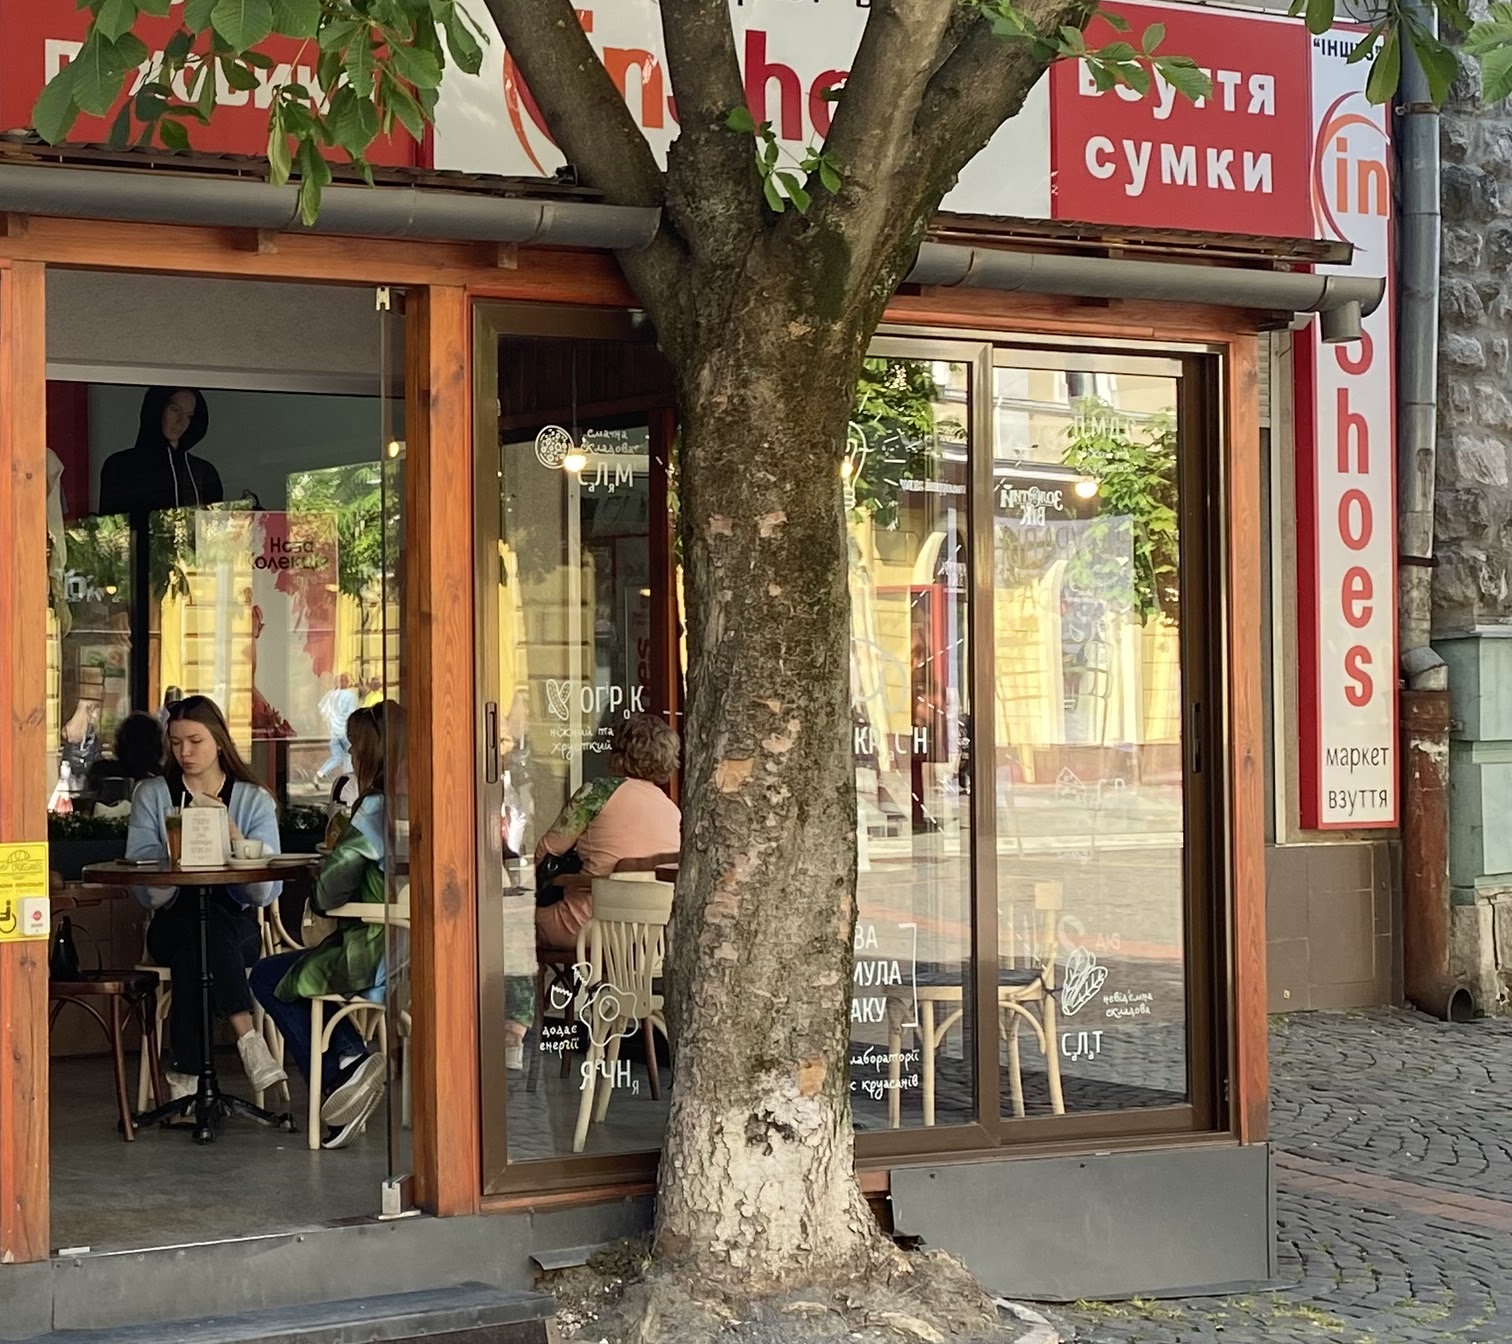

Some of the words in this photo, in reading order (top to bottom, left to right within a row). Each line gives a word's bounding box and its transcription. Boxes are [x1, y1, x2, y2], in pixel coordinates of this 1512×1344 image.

[1084, 135, 1274, 197] сумки
[1336, 137, 1388, 217] in
[1325, 746, 1390, 774] маркет
[1327, 788, 1389, 817] взуття
[850, 996, 887, 1024] АКУ
